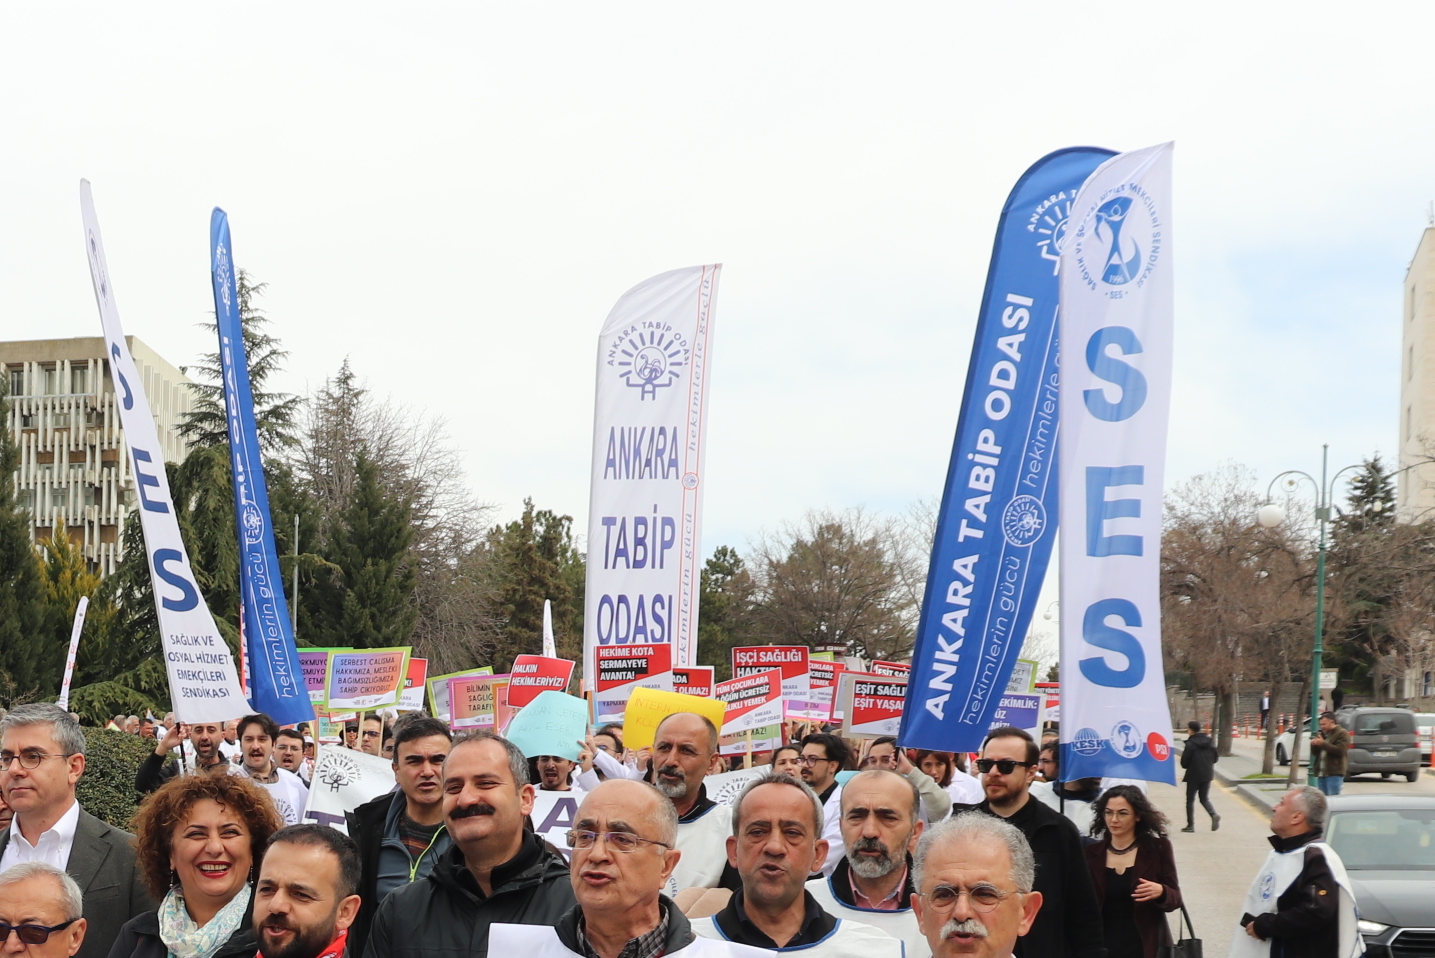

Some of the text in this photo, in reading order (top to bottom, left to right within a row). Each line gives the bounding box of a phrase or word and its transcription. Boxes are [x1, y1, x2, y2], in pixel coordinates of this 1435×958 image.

[1027, 191, 1066, 232] ANKARA
[607, 325, 638, 367] ANKARA
[641, 321, 672, 332] TABİP
[603, 425, 681, 481] ANKARA
[925, 293, 1034, 722] ANKARA TABİP ODASI
[601, 504, 677, 570] TABİP
[252, 551, 293, 698] hekimlerin gücü
[596, 593, 673, 645] ODASI
[170, 633, 215, 647] SAĞLIK VE
[963, 556, 1021, 725] hekimlerin gücü
[168, 651, 229, 665] OSYAL HİZMET
[600, 646, 654, 658] HEKİME KOTA
[736, 649, 757, 665] İŞÇİ
[759, 649, 802, 662] SAĞLIĞI
[514, 664, 538, 674] HALKIN
[600, 659, 647, 669] SERMAYEYE
[809, 663, 834, 671] CUKLARA
[176, 668, 227, 684] EMEKÇİLERİ
[336, 667, 372, 675] HAKKIMIZA,
[600, 671, 635, 681] AVANTA!
[511, 675, 564, 687] HEKİMLERİYİZ!
[717, 675, 769, 695] TÜM ÇOCUKLARA
[181, 686, 230, 699] SENDİKASI
[340, 685, 358, 694] SAHİP
[467, 684, 491, 693] BİLİMİN
[679, 686, 709, 695] OLMAZ!
[740, 685, 770, 698] ÜCRETSİZ
[856, 683, 875, 696] EŞİT
[744, 697, 767, 708] YEMEK
[855, 696, 875, 711] EŞİT
[999, 697, 1037, 709] EKİMLİK:
[1071, 739, 1106, 751] KESK
